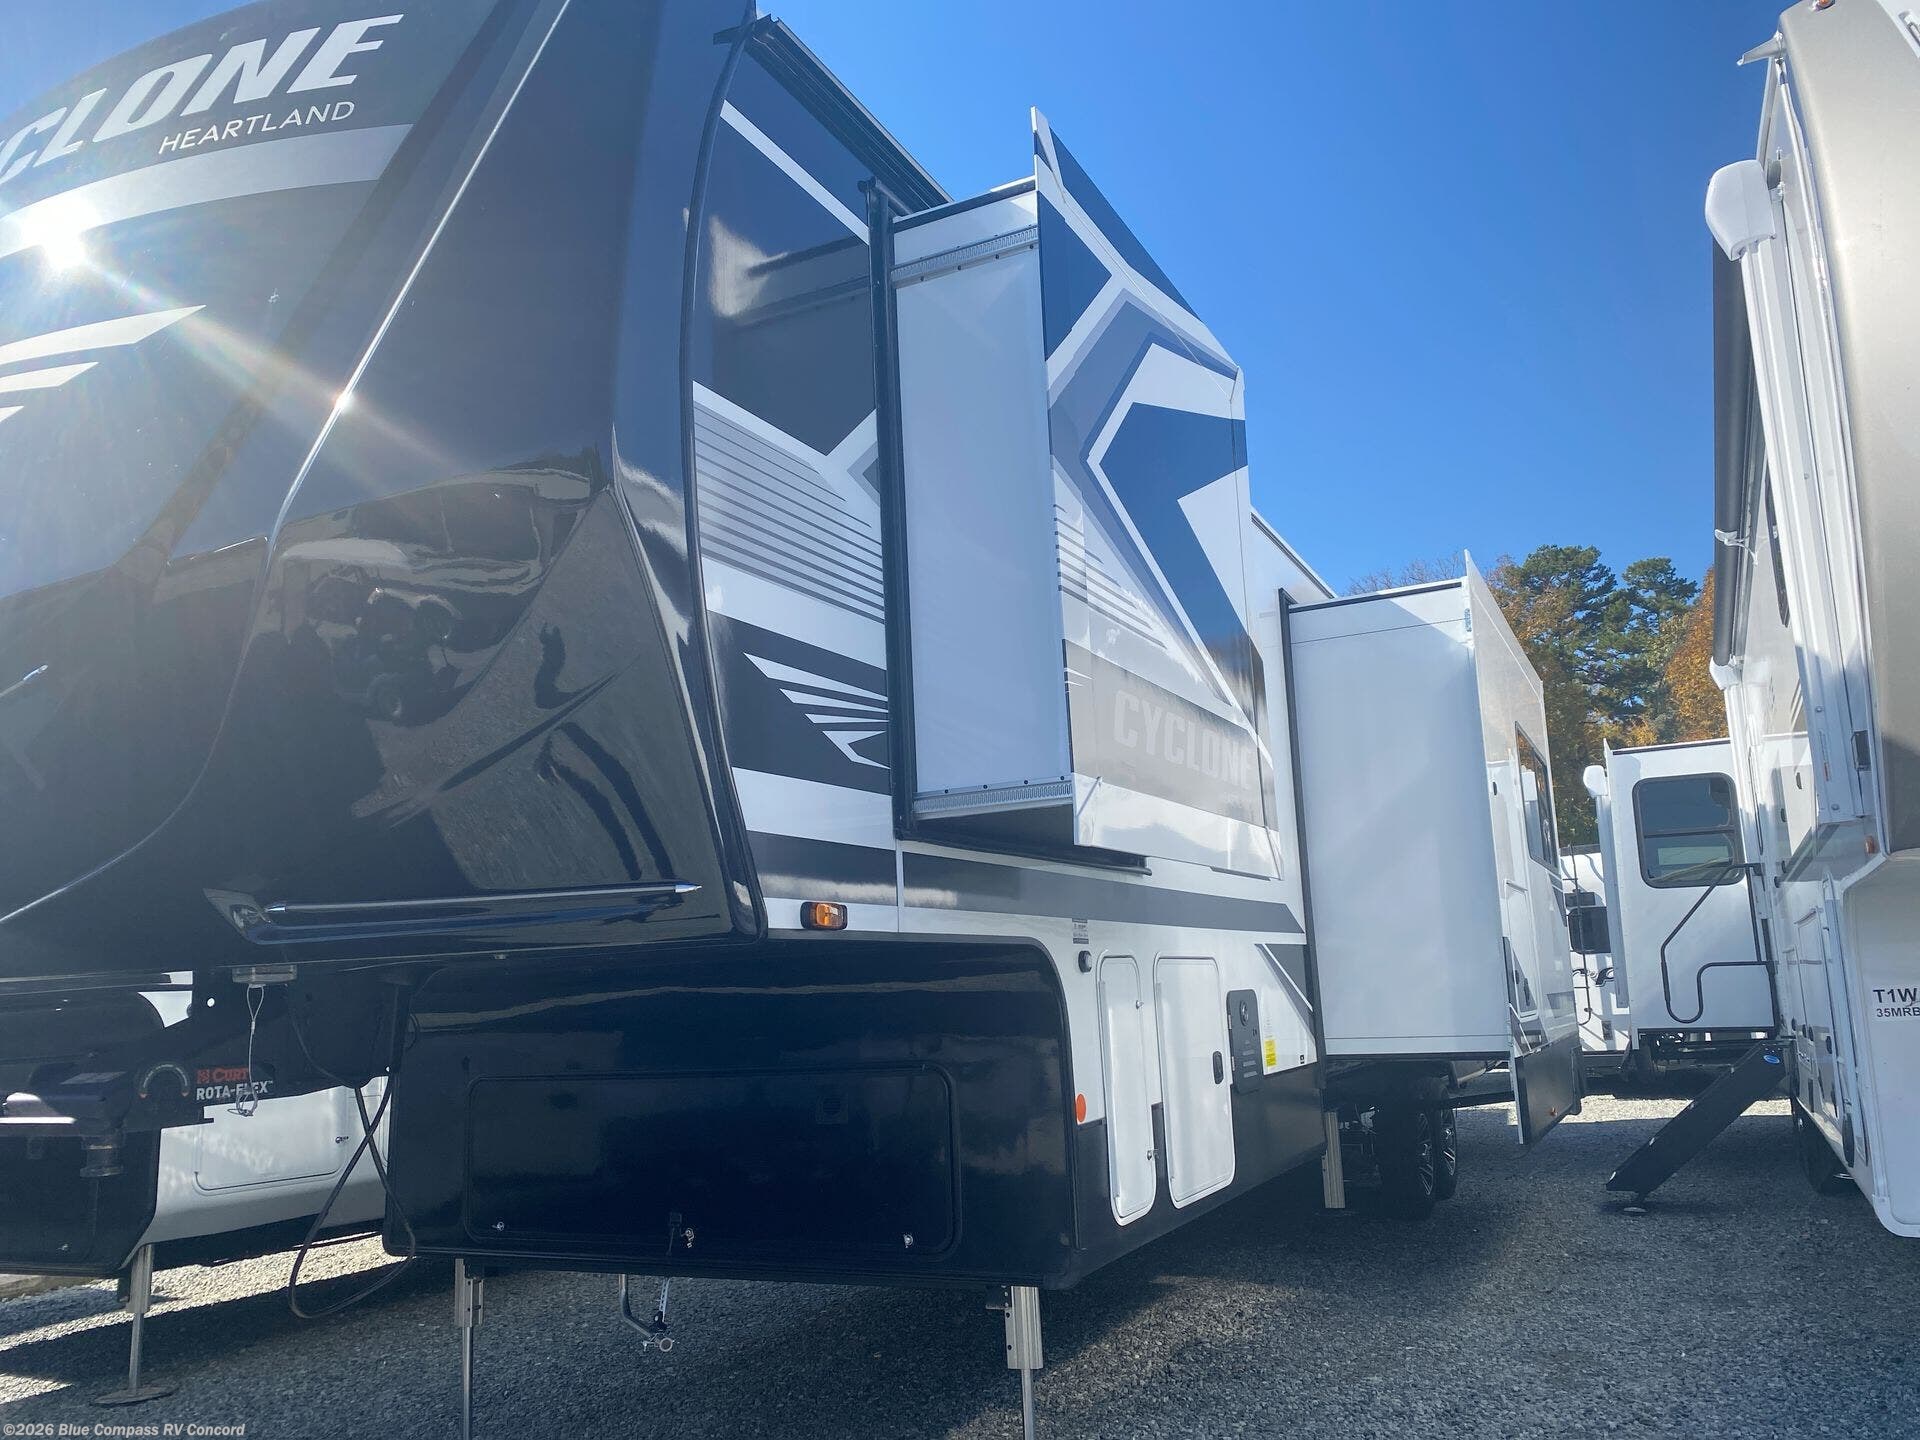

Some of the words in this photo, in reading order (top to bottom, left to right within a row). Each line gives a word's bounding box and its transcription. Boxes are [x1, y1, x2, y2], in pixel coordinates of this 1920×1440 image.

[0, 14, 404, 185] CLONE
[158, 101, 355, 155] HEARTLAND
[1113, 690, 1254, 790] CYCLONE
